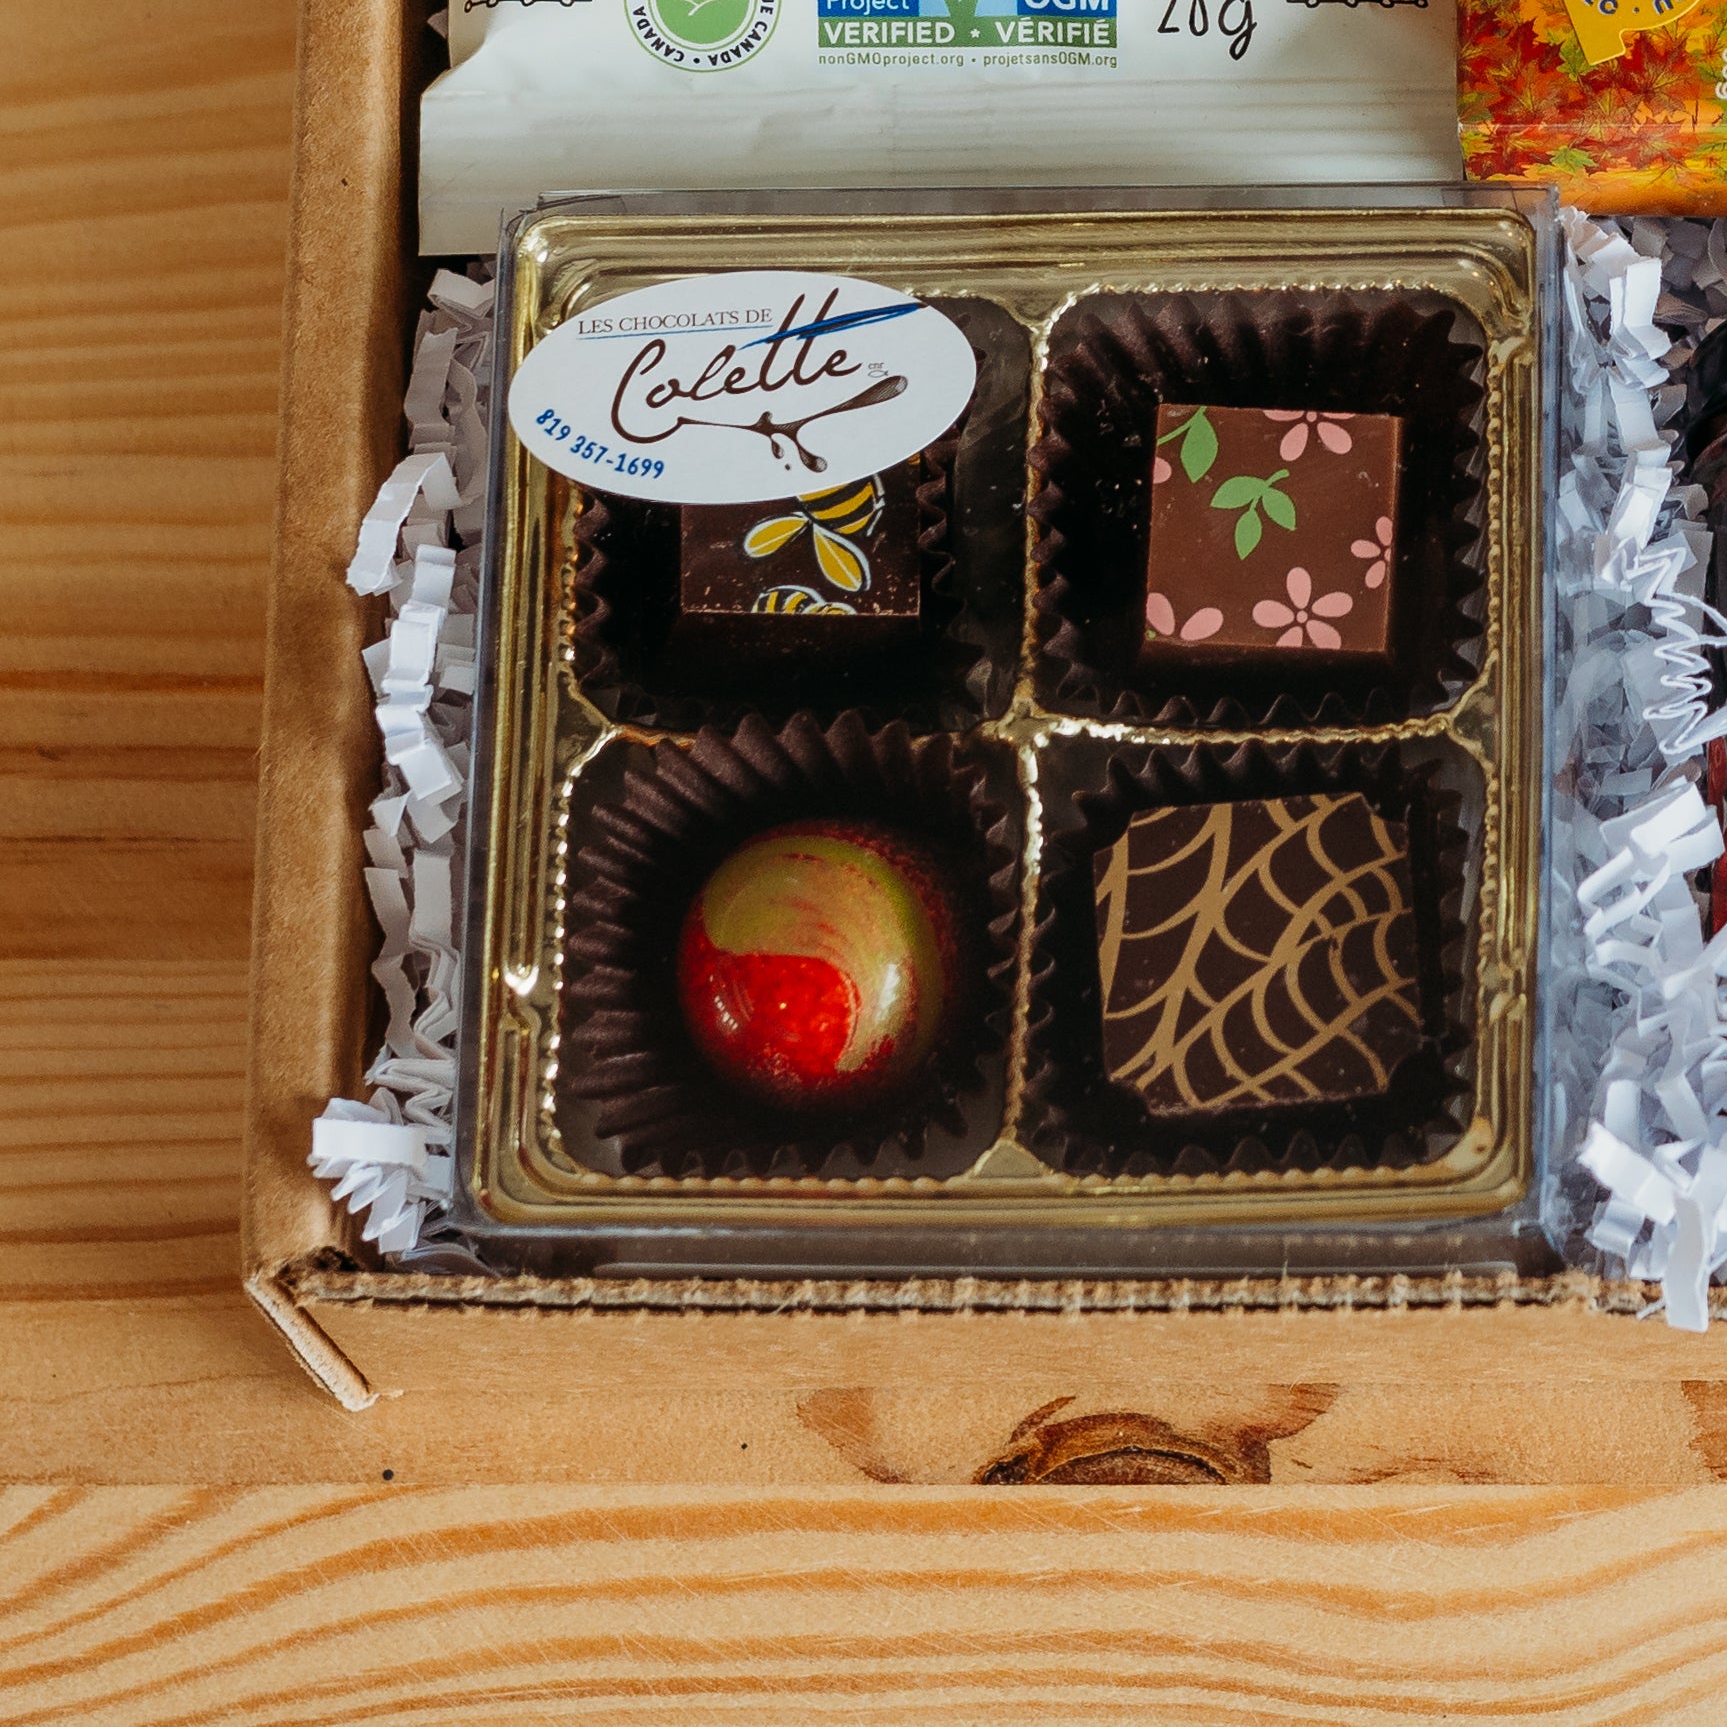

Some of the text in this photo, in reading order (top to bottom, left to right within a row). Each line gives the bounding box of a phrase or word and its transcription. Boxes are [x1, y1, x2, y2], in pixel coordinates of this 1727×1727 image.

[632, 5, 685, 63] CANADA
[707, 21, 768, 66] CANADA
[823, 18, 1111, 46] VERIFIED VÉRIFIÉ
[818, 51, 1118, 68] nonGMOproject.org projetsansOGM.org
[578, 309, 772, 334] LES CHOCOLATS DE
[612, 287, 915, 444] Colette
[535, 408, 665, 479] 819 357-1699
